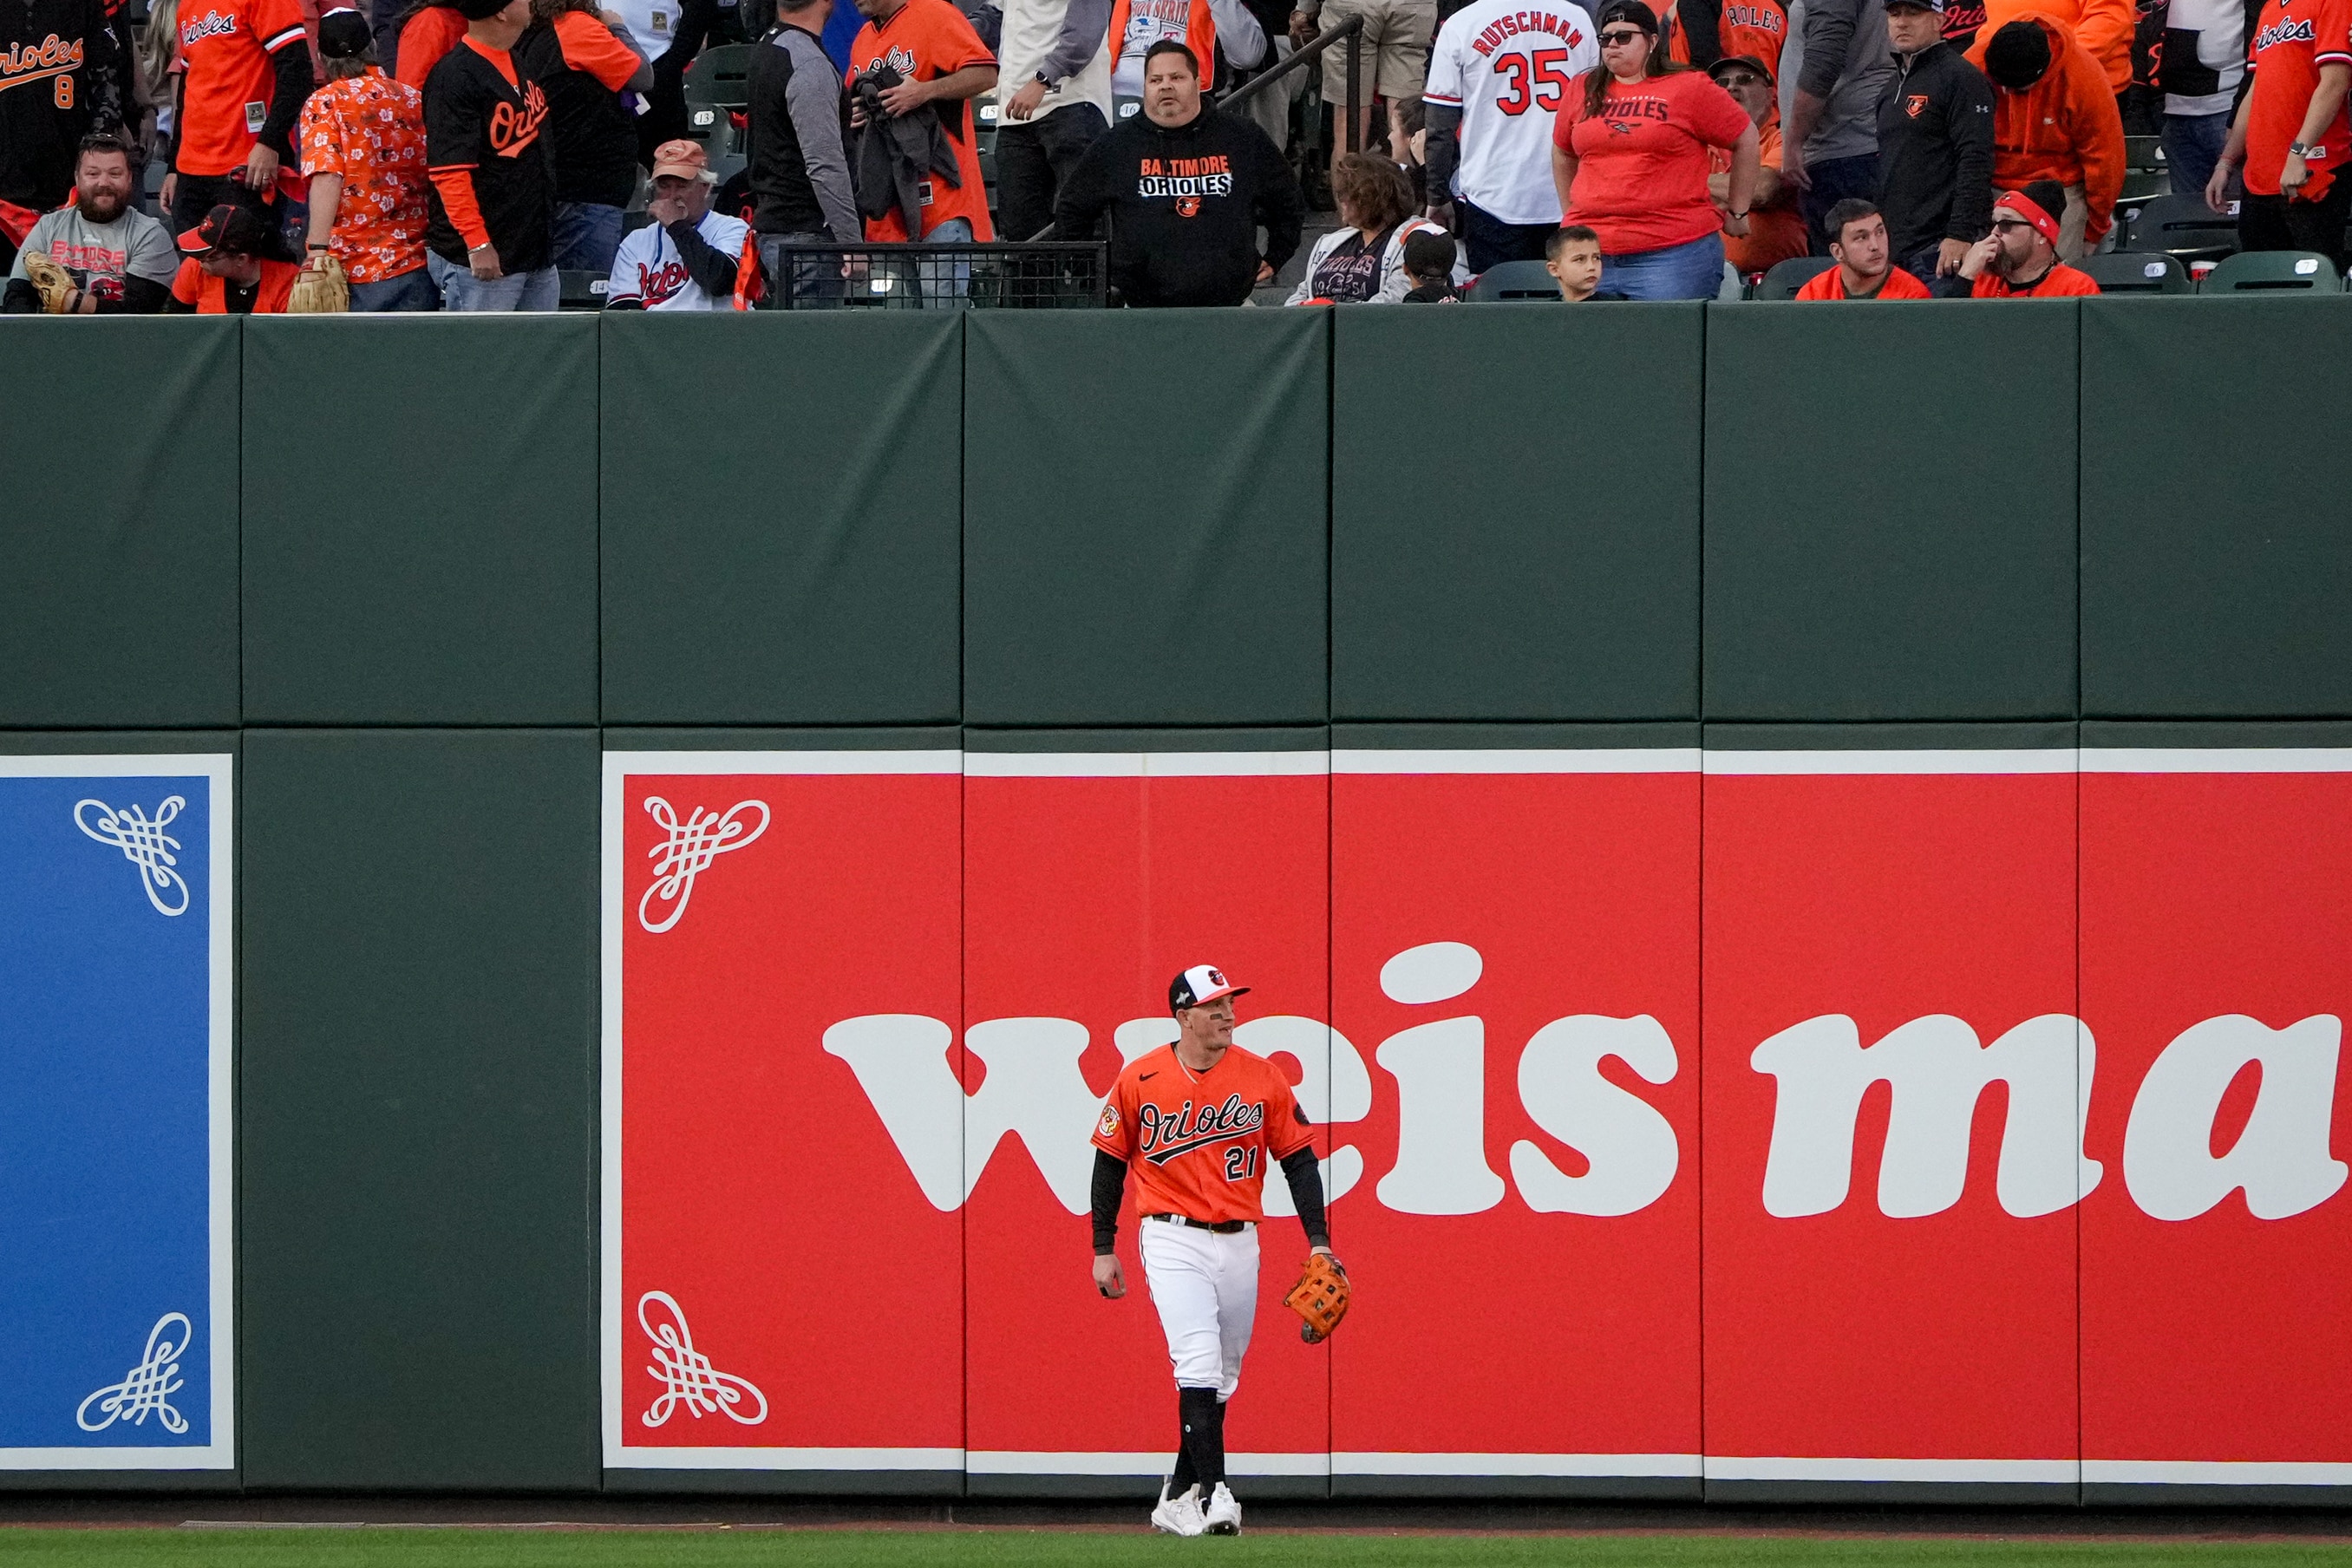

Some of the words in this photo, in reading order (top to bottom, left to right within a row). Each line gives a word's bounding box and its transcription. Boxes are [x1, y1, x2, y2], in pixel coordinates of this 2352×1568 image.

[1472, 11, 1584, 58] RUTSCHMAN
[0, 33, 84, 75] rioles
[54, 75, 74, 109] 8
[1493, 48, 1571, 116] 35
[490, 80, 548, 151] Oriole
[699, 113, 709, 123] 13
[985, 107, 996, 117] 15
[1125, 105, 1136, 114] 16
[1140, 155, 1230, 177] BATIMORE
[1142, 174, 1230, 195] ORIOLES
[51, 255, 126, 277] BASEBAL
[822, 941, 1679, 1217] weis
[1750, 1013, 2349, 1221] ma
[1140, 1093, 1264, 1162] Orioles
[1225, 1145, 1258, 1182] 21
